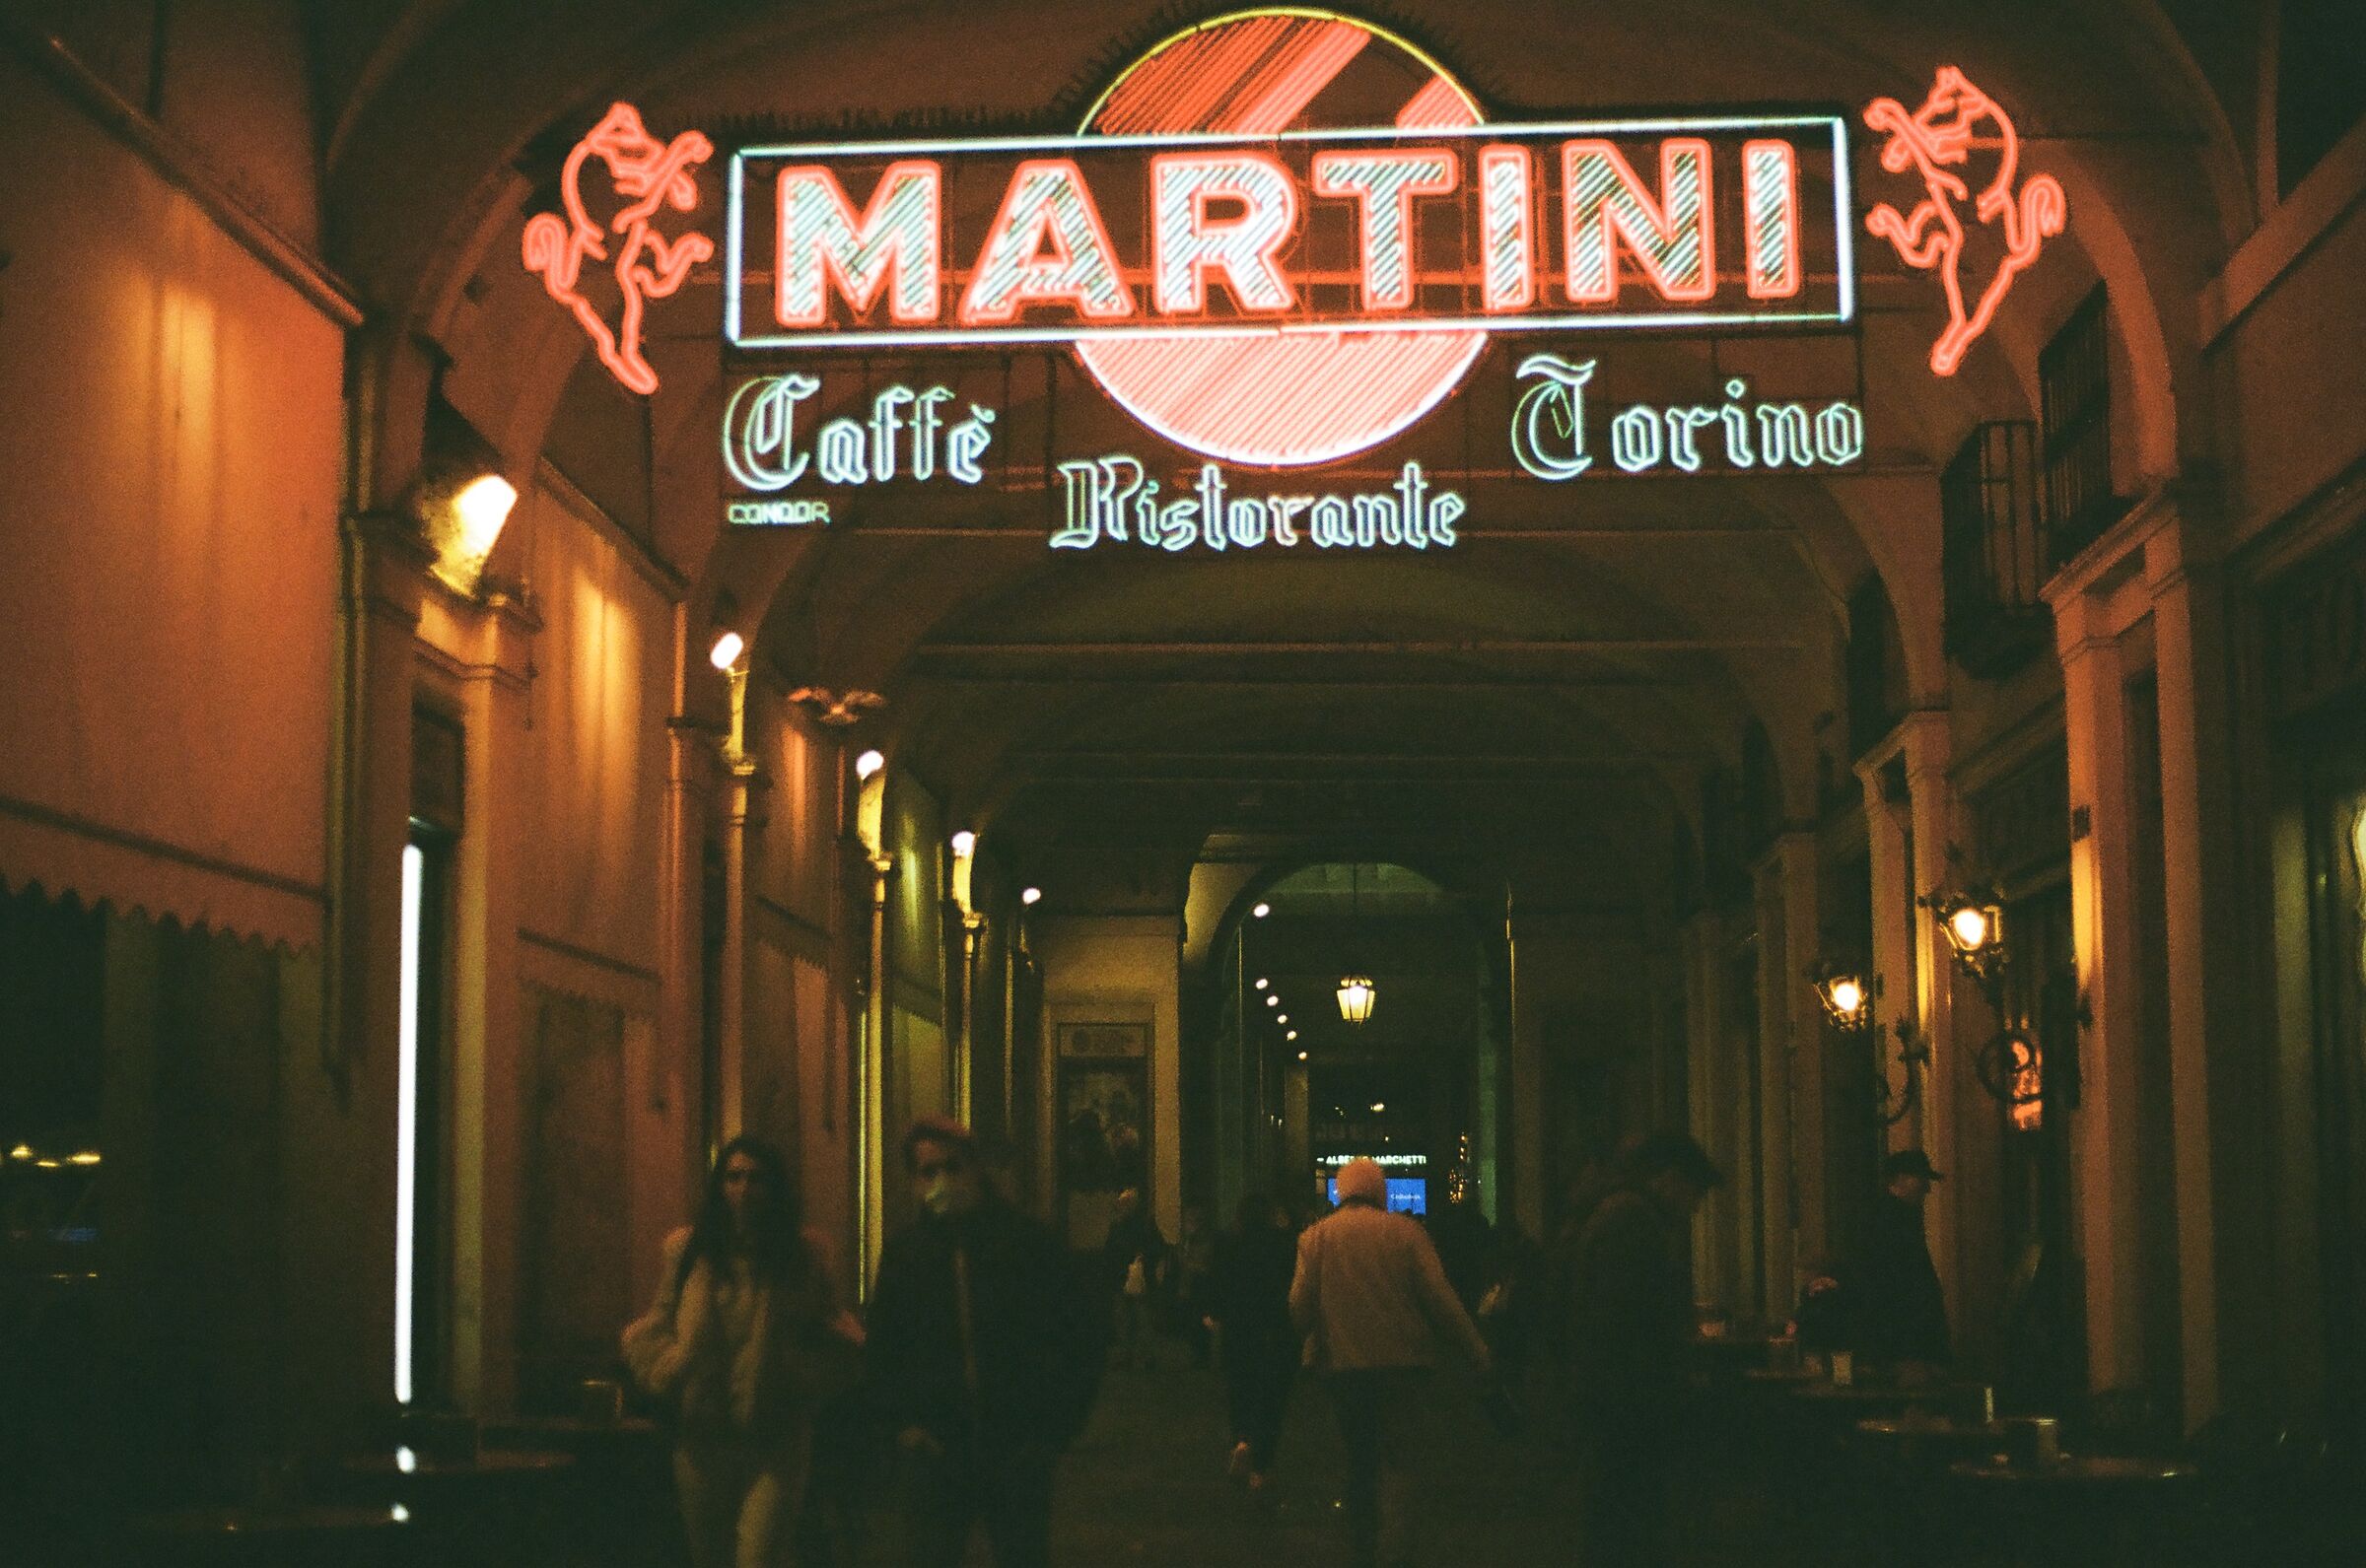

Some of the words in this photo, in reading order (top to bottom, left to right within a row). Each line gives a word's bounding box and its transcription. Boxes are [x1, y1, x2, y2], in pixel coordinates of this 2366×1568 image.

[775, 137, 1800, 328] MARTINI
[722, 373, 996, 492] Caffè
[1510, 352, 1864, 481] Torino
[728, 501, 830, 524] CONDOR
[1049, 454, 1466, 552] Ristorante
[1326, 1155, 1368, 1164] ALBE
